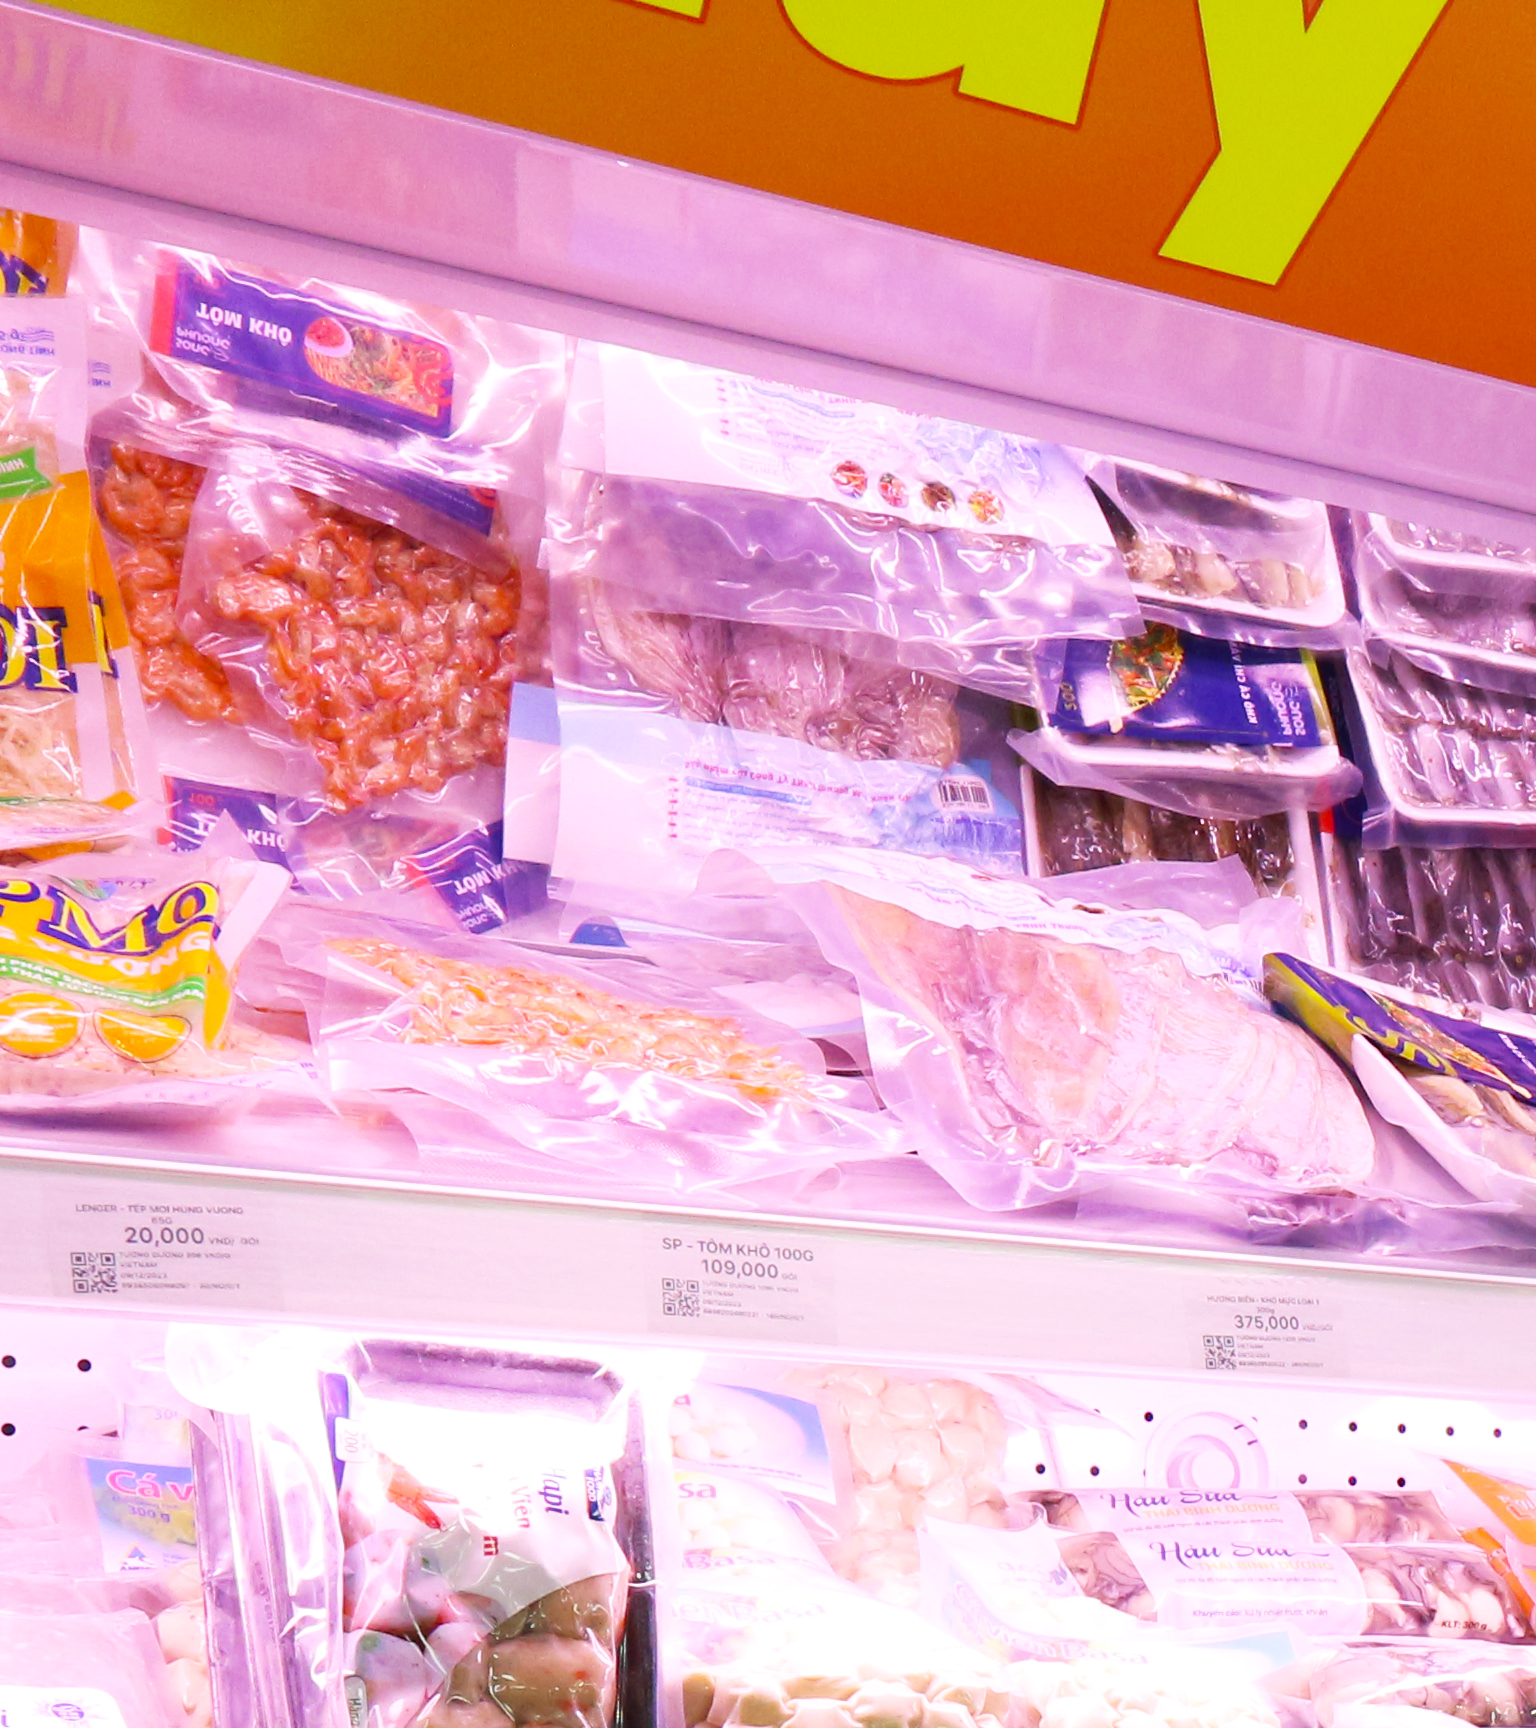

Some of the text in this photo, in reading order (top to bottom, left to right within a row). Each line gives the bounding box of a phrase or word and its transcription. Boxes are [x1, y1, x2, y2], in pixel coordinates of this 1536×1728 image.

[124, 1225, 205, 1248] 20,000
[661, 1235, 815, 1263] SP TÔM KHÔ 100G
[700, 1257, 780, 1280] 109,000
[1233, 1314, 1300, 1333] 375,000
[105, 1470, 161, 1500] Cá
